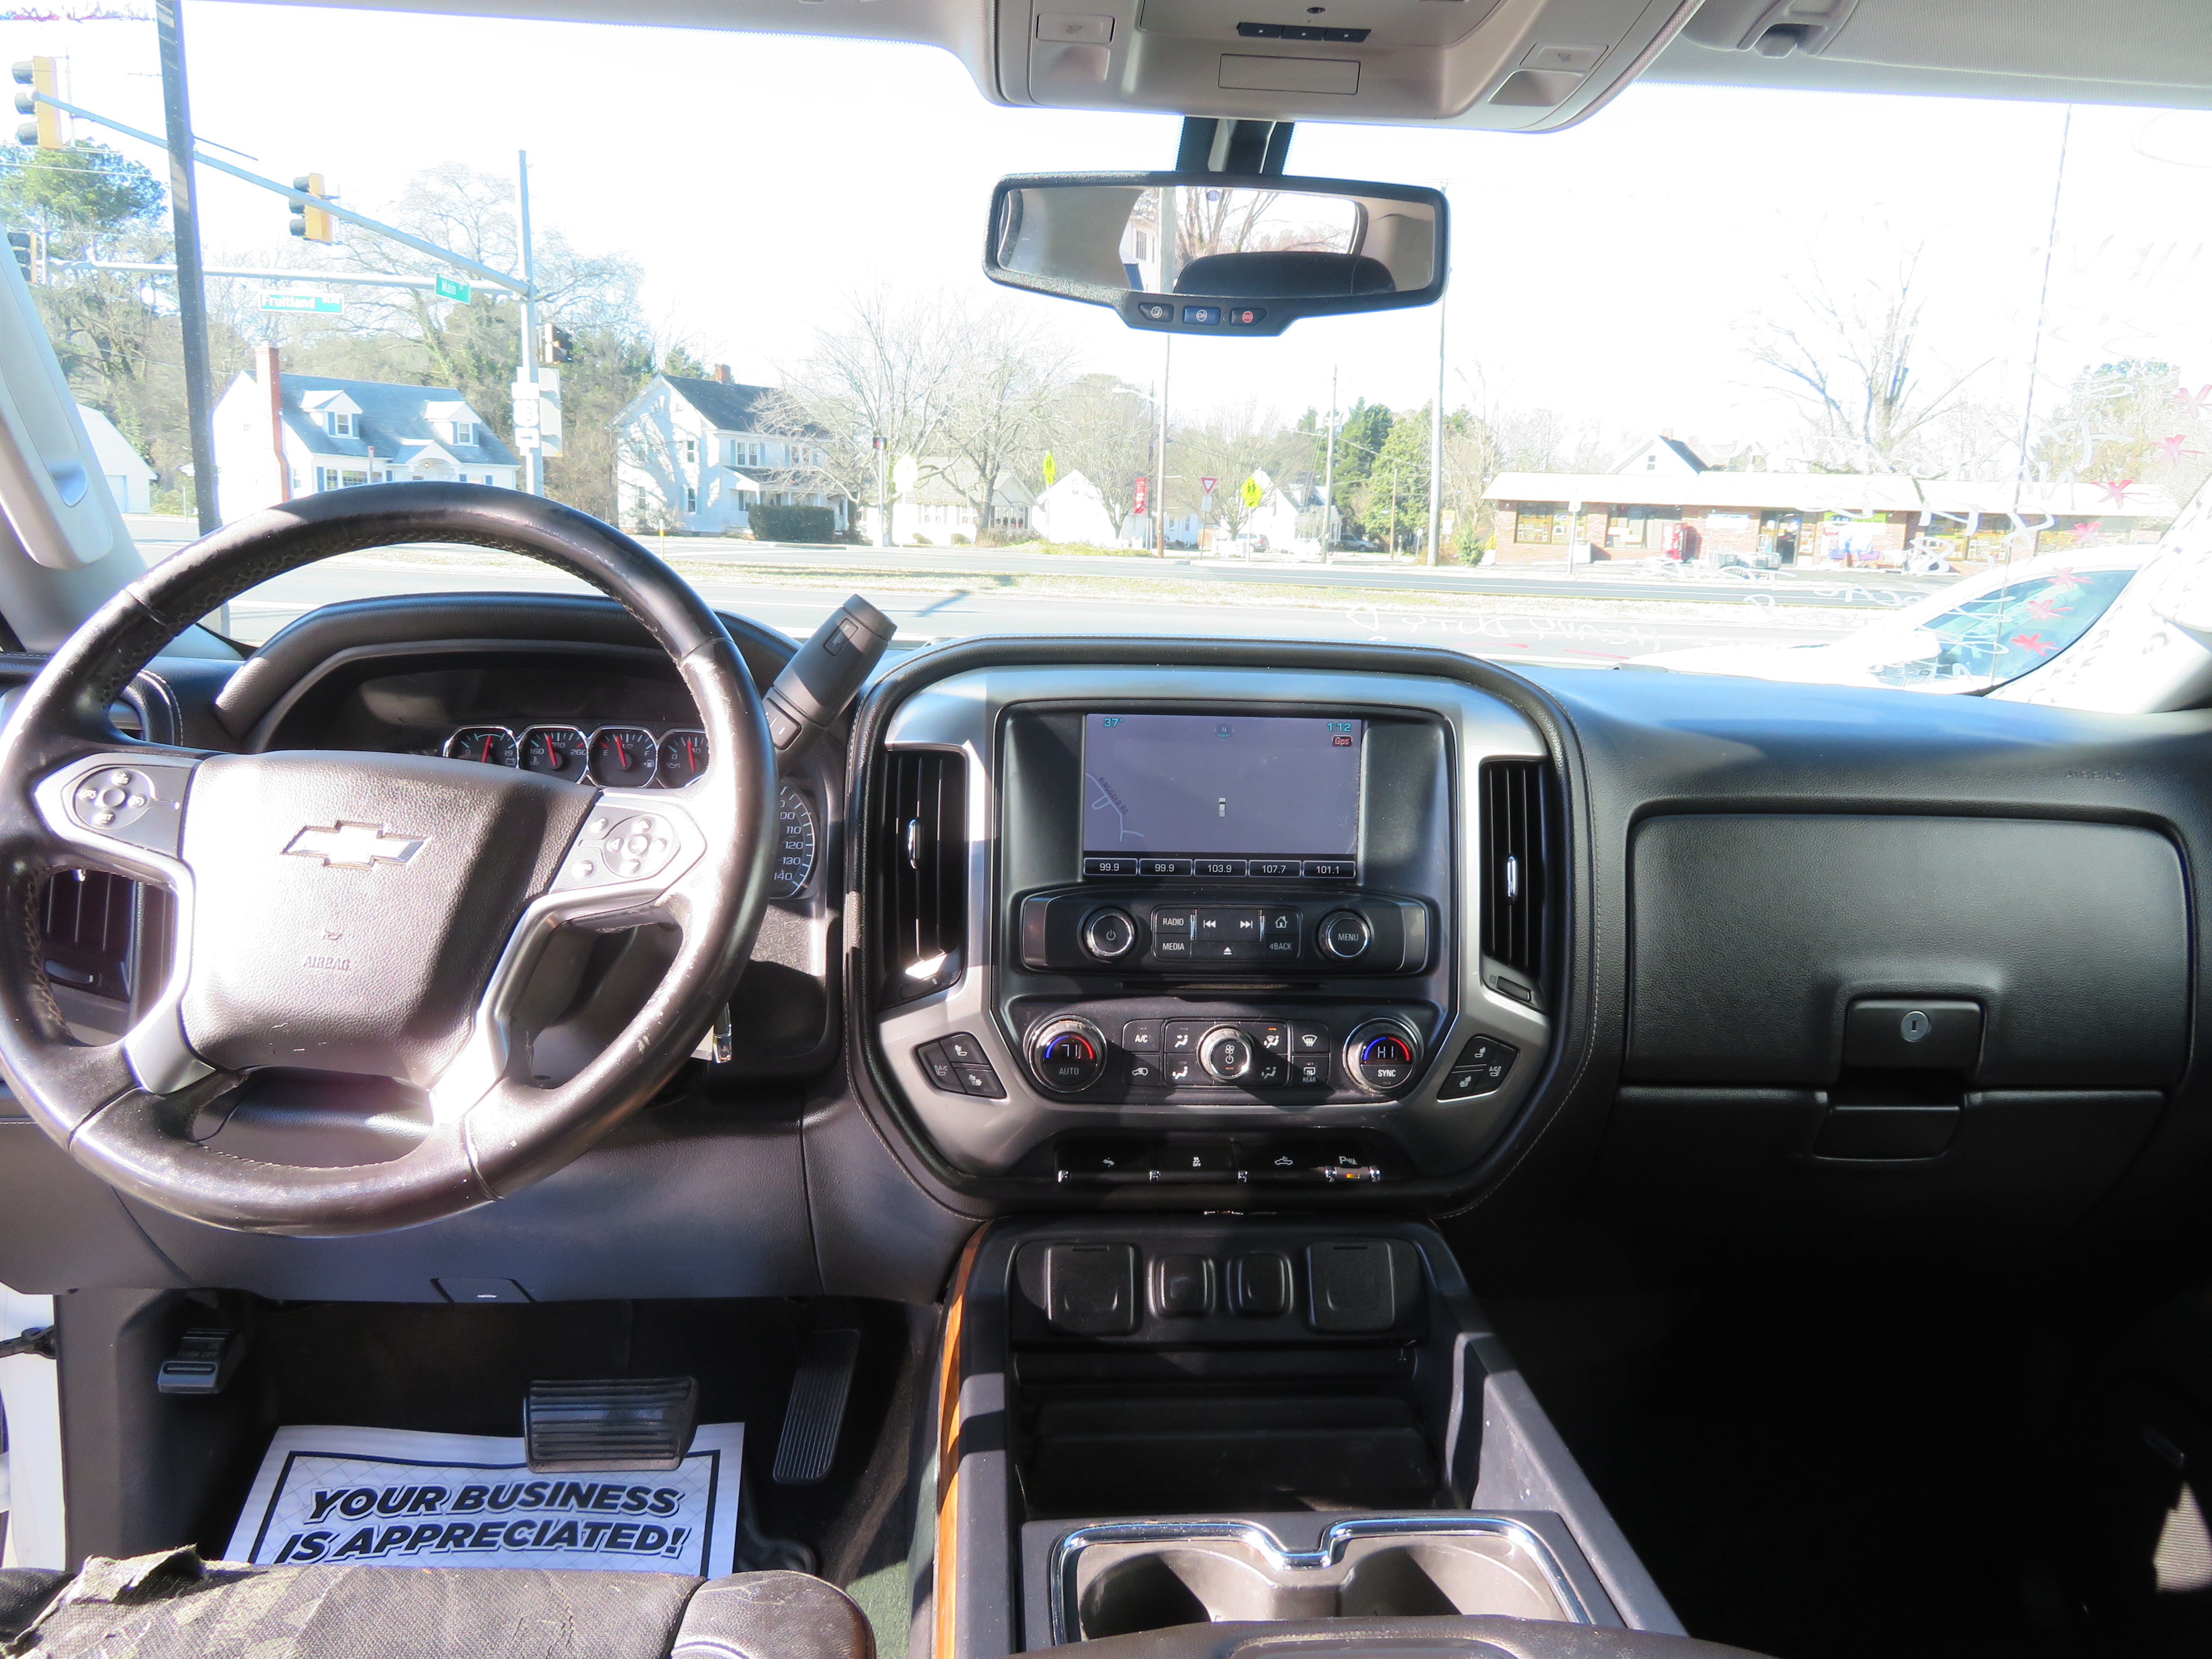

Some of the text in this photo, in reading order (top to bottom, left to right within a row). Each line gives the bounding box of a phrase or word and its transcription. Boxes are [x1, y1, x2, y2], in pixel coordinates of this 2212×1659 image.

[441, 279, 456, 295] Main
[262, 294, 316, 309] Fruitland
[1103, 717, 1124, 728] 37°
[1327, 722, 1352, 732] 1:12
[1098, 777, 1122, 806] RINGGOLD
[786, 826, 802, 834] 110
[785, 841, 803, 850] 120
[782, 857, 801, 865] 130
[1099, 862, 1340, 874] 99.9 99.9 103.9 107.7 101.1
[774, 872, 793, 881] 140
[1162, 917, 1184, 927] RADIO
[1338, 932, 1359, 942] MENU
[1162, 942, 1185, 952] MEDIA
[1274, 941, 1292, 952] BACK
[303, 956, 350, 971] AIRBAG
[1135, 1035, 1148, 1043] A/C
[1377, 1047, 1396, 1059] HI
[1059, 1067, 1080, 1076] AUTO
[1377, 1068, 1396, 1078] SYNC
[309, 1481, 684, 1520] YOUR BUSINESS
[277, 1518, 693, 1564] IS APPRECIATED!
